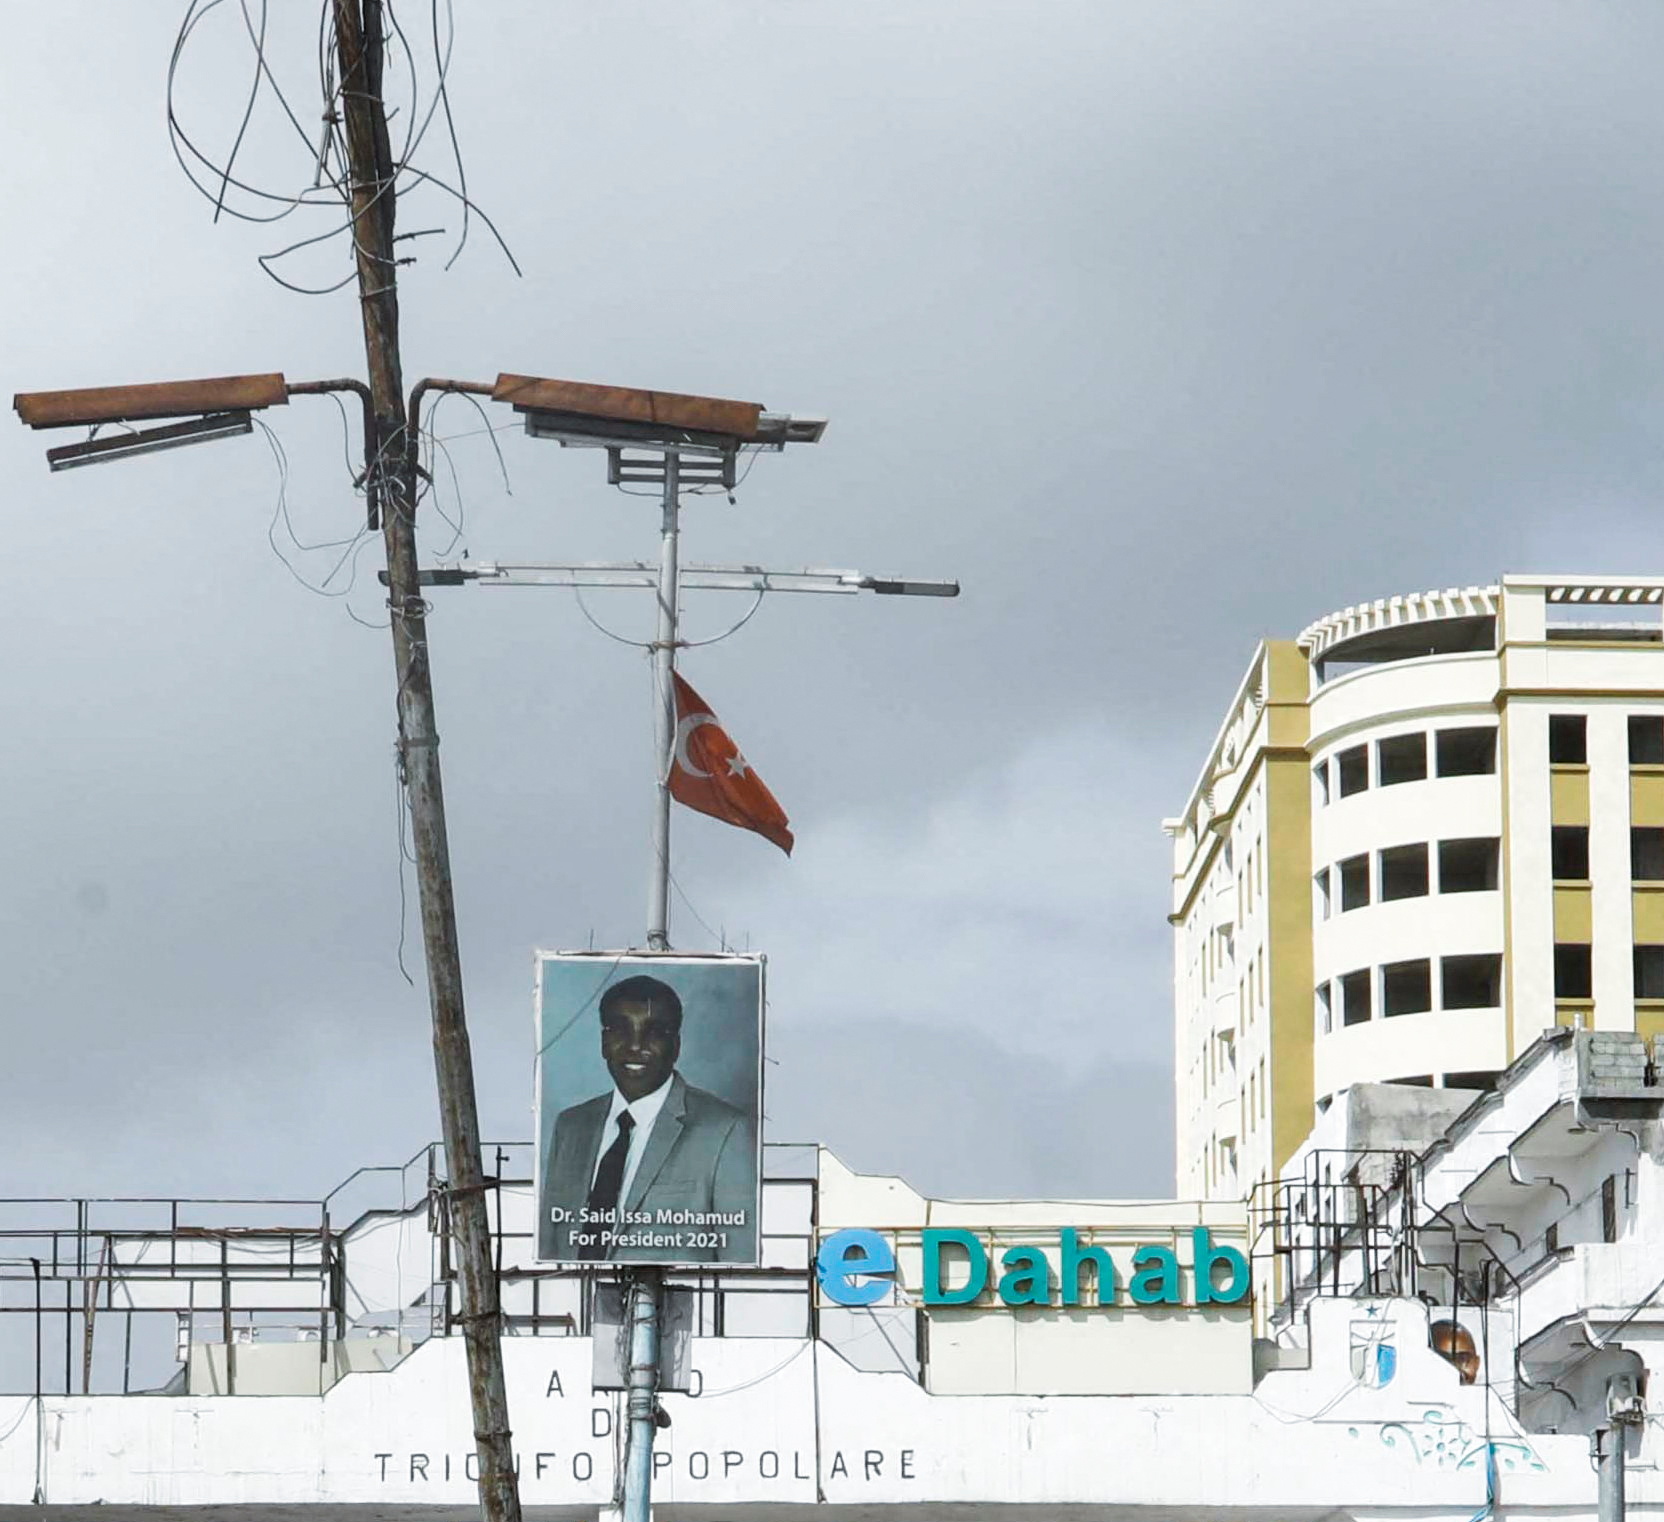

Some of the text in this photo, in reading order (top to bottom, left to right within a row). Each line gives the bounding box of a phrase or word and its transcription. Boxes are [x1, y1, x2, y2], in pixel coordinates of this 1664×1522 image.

[551, 1207, 745, 1226] Dr. Said Issa Mohamud
[569, 1231, 727, 1248] For President 2021
[921, 1226, 1251, 1307] Dahab
[375, 1449, 915, 1481] TRIOFO POPOLARE
